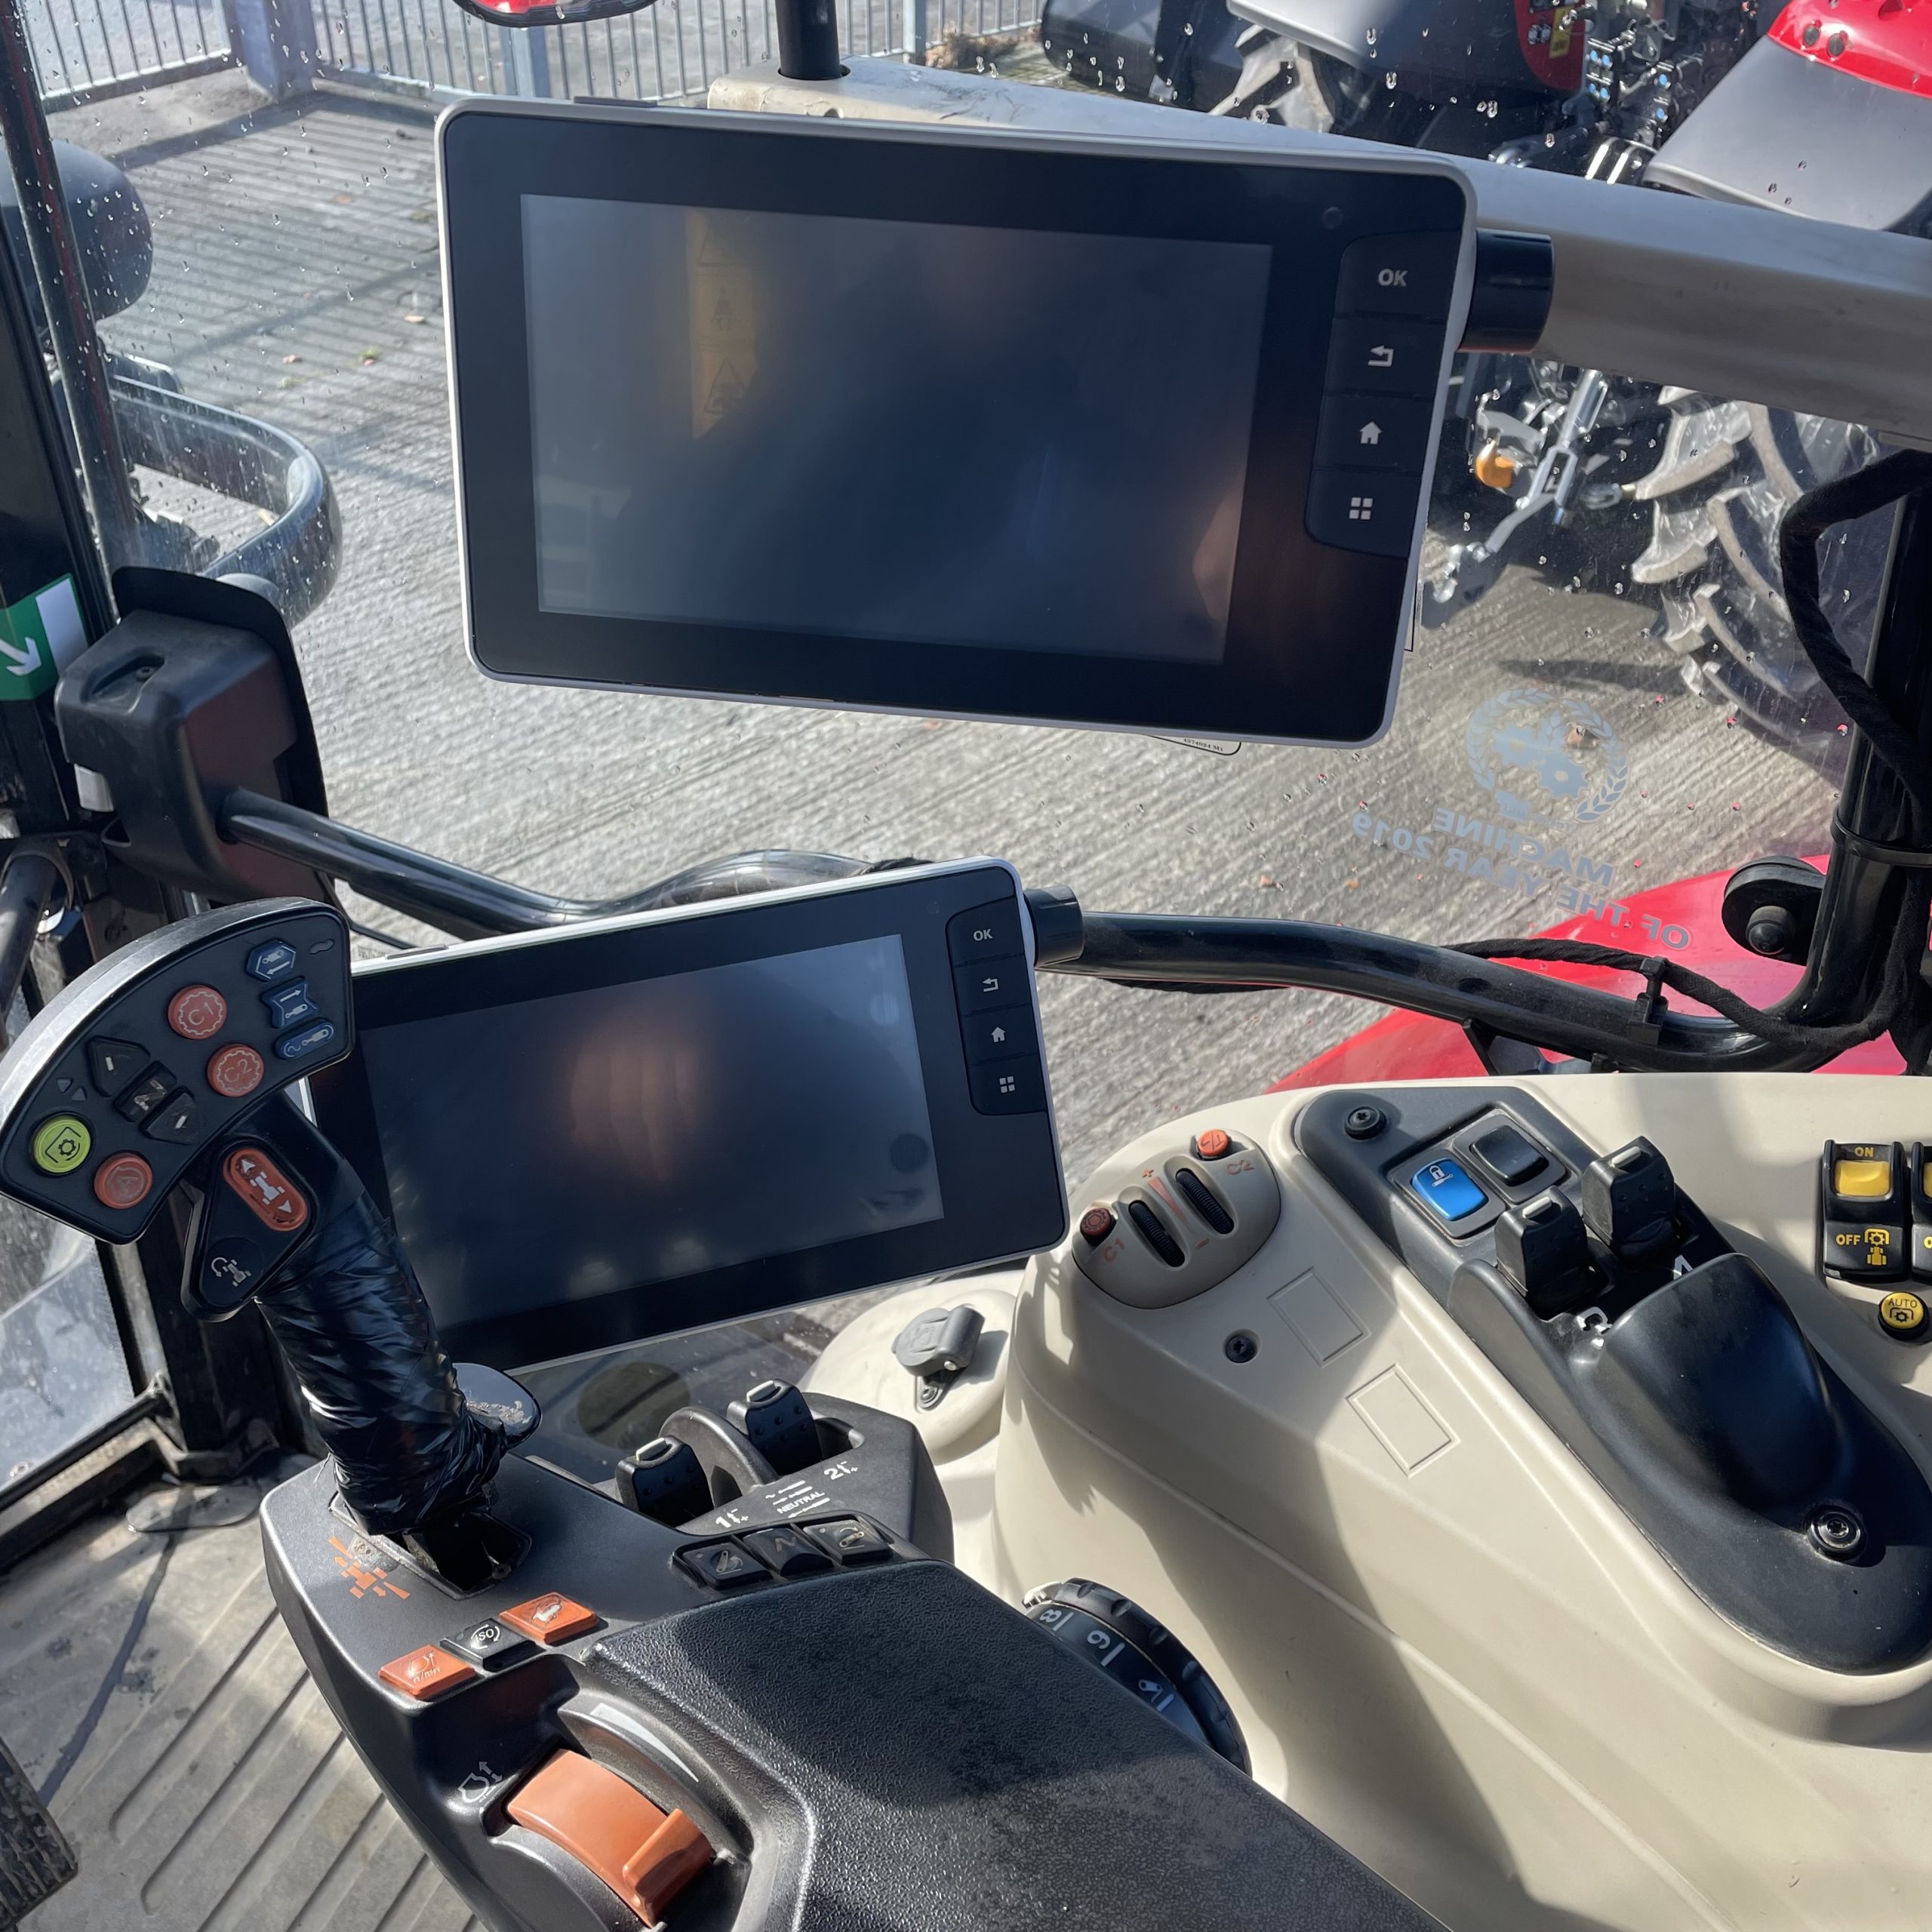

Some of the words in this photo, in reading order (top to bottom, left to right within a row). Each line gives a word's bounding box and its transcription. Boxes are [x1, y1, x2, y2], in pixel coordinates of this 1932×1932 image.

[1378, 269, 1407, 287] OK
[973, 928, 993, 941] OK
[189, 1001, 214, 1026] C1
[224, 1059, 252, 1083] C2
[1854, 1146, 1874, 1158] ON
[1225, 1158, 1254, 1176] C2
[1835, 1234, 1861, 1246] OFF
[1102, 1238, 1124, 1263] C1
[1887, 1297, 1918, 1309] AUTO
[777, 1491, 826, 1514] NEUTRAL
